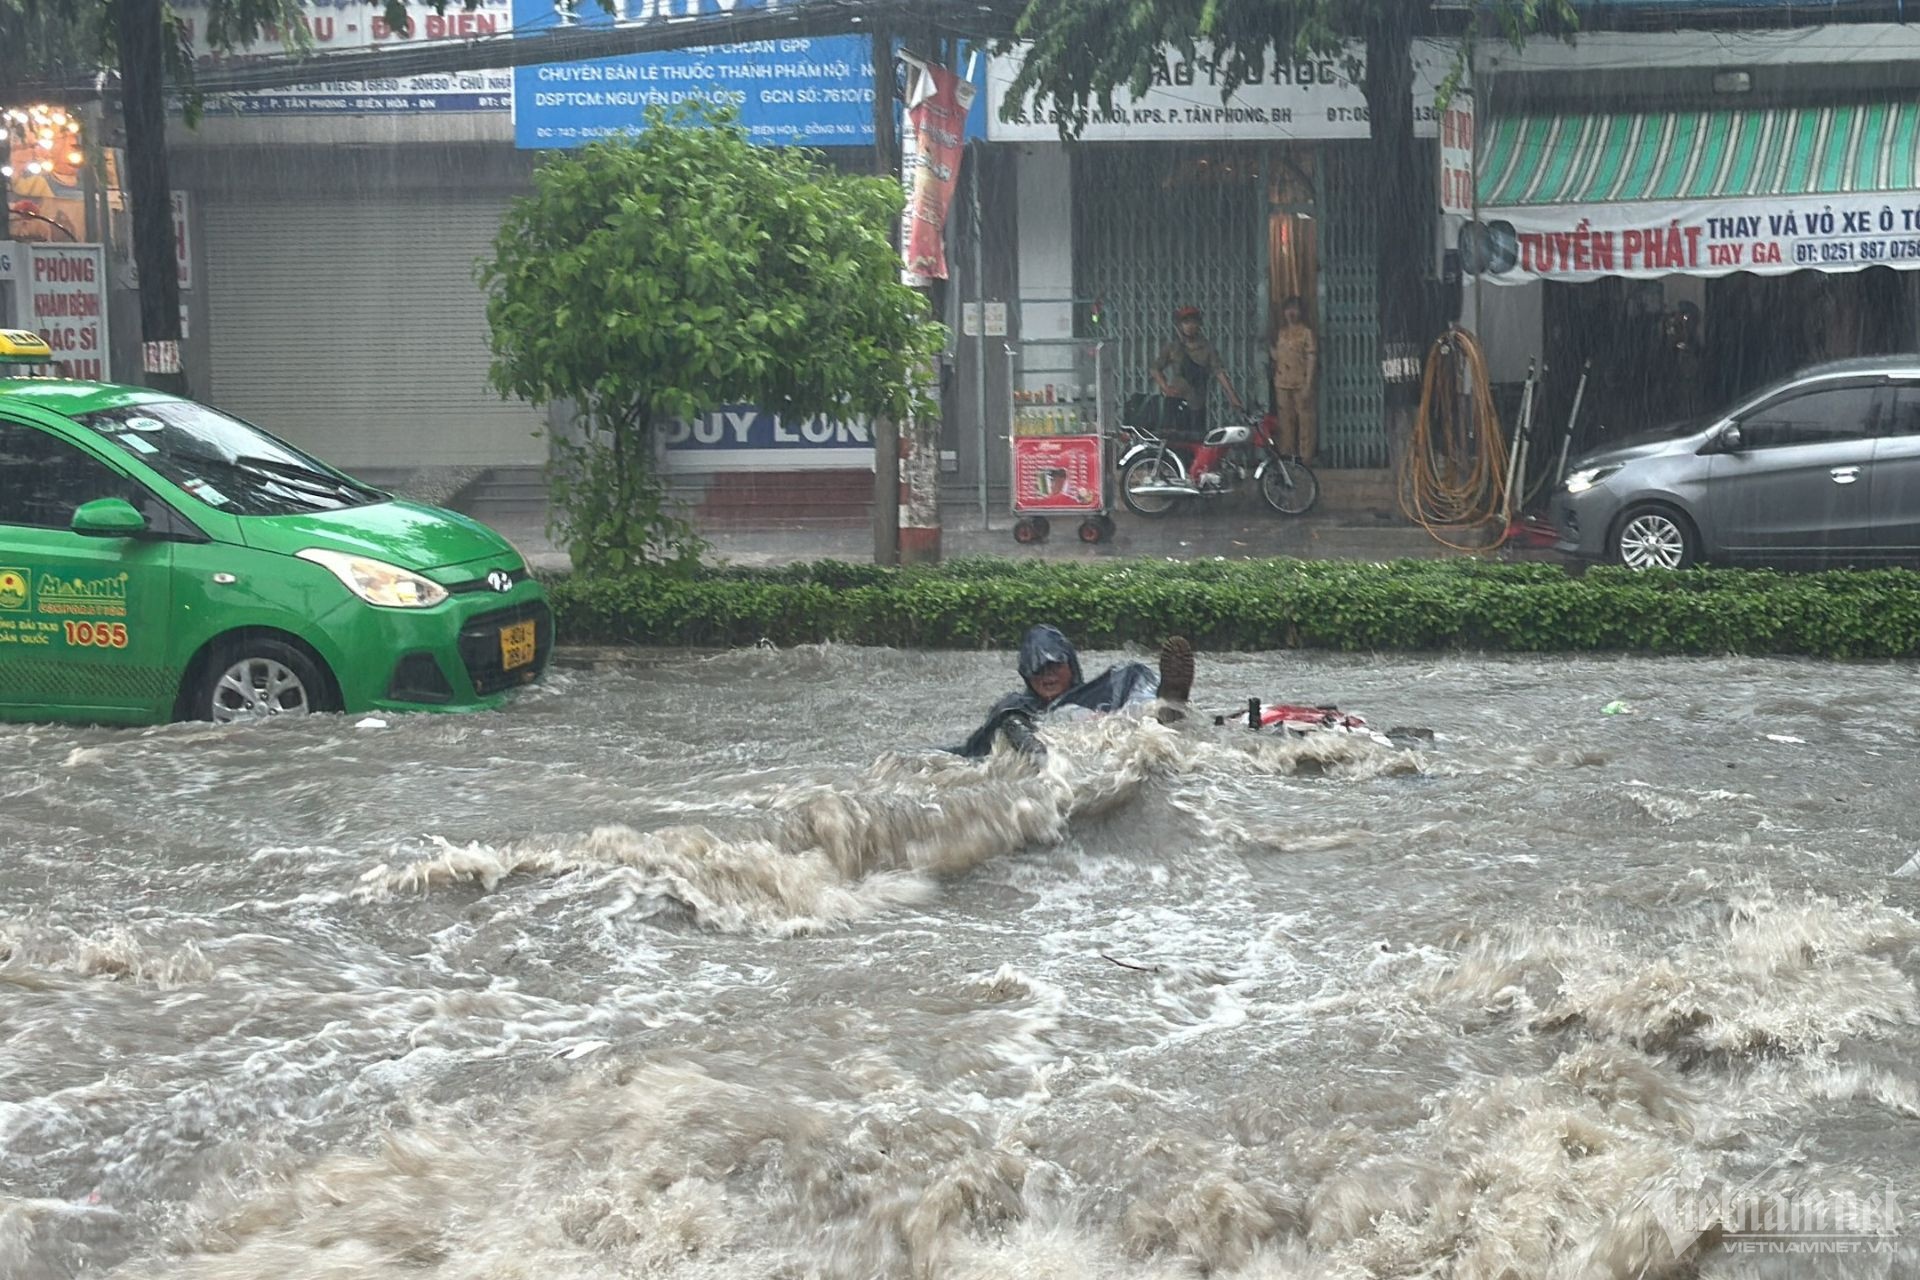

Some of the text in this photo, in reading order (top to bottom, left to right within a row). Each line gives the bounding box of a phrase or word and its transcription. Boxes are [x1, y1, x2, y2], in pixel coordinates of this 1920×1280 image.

[760, 90, 794, 104] GCN
[1707, 216, 1761, 239] THAY
[1842, 211, 1871, 233] XE
[1879, 204, 1894, 231] Ô
[1623, 218, 1702, 269] PHÁT
[1707, 243, 1744, 265] TAY
[1752, 242, 1782, 264] GA
[1822, 242, 1855, 261] 0251
[1860, 241, 1885, 260] 887
[34, 251, 95, 282] PHÒNG
[63, 620, 128, 648] 1055
